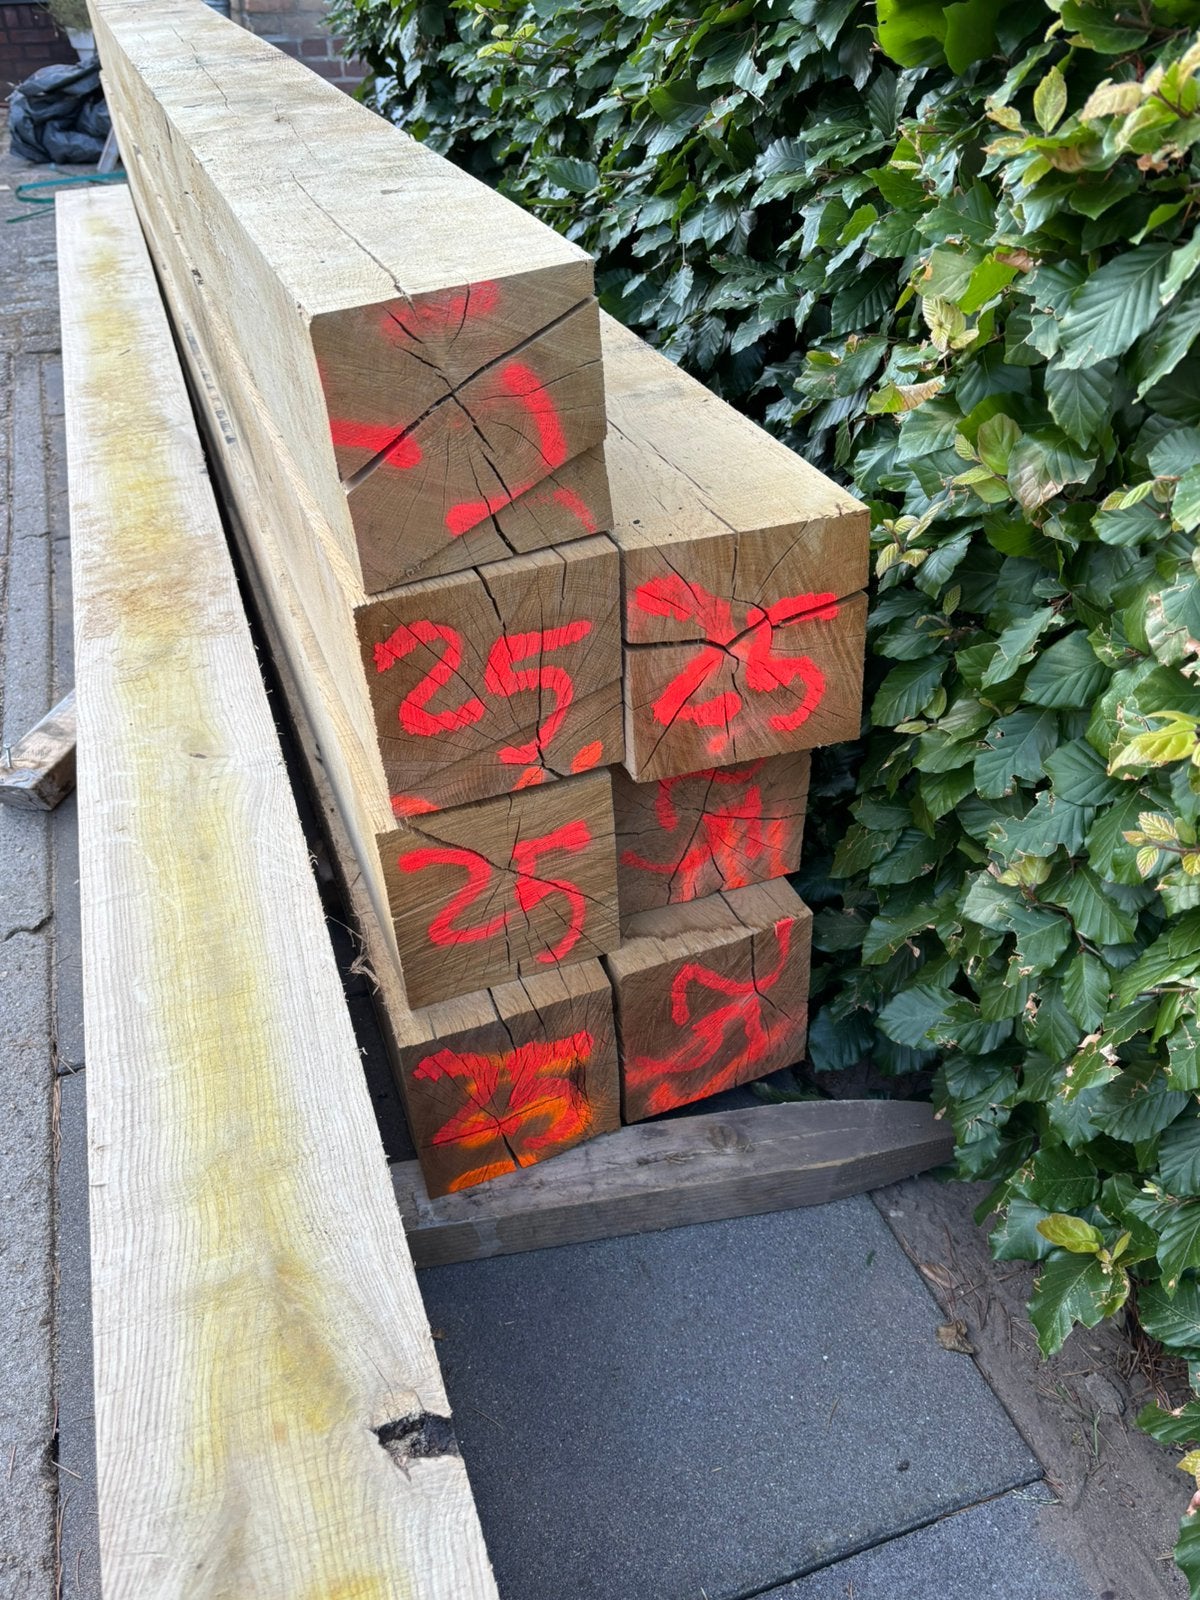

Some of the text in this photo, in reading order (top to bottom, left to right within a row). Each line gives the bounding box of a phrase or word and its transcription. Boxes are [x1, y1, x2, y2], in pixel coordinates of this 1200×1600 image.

[372, 618, 593, 765] 25
[636, 574, 839, 732] 25
[399, 819, 591, 964] 25
[412, 1030, 594, 1149] 25
